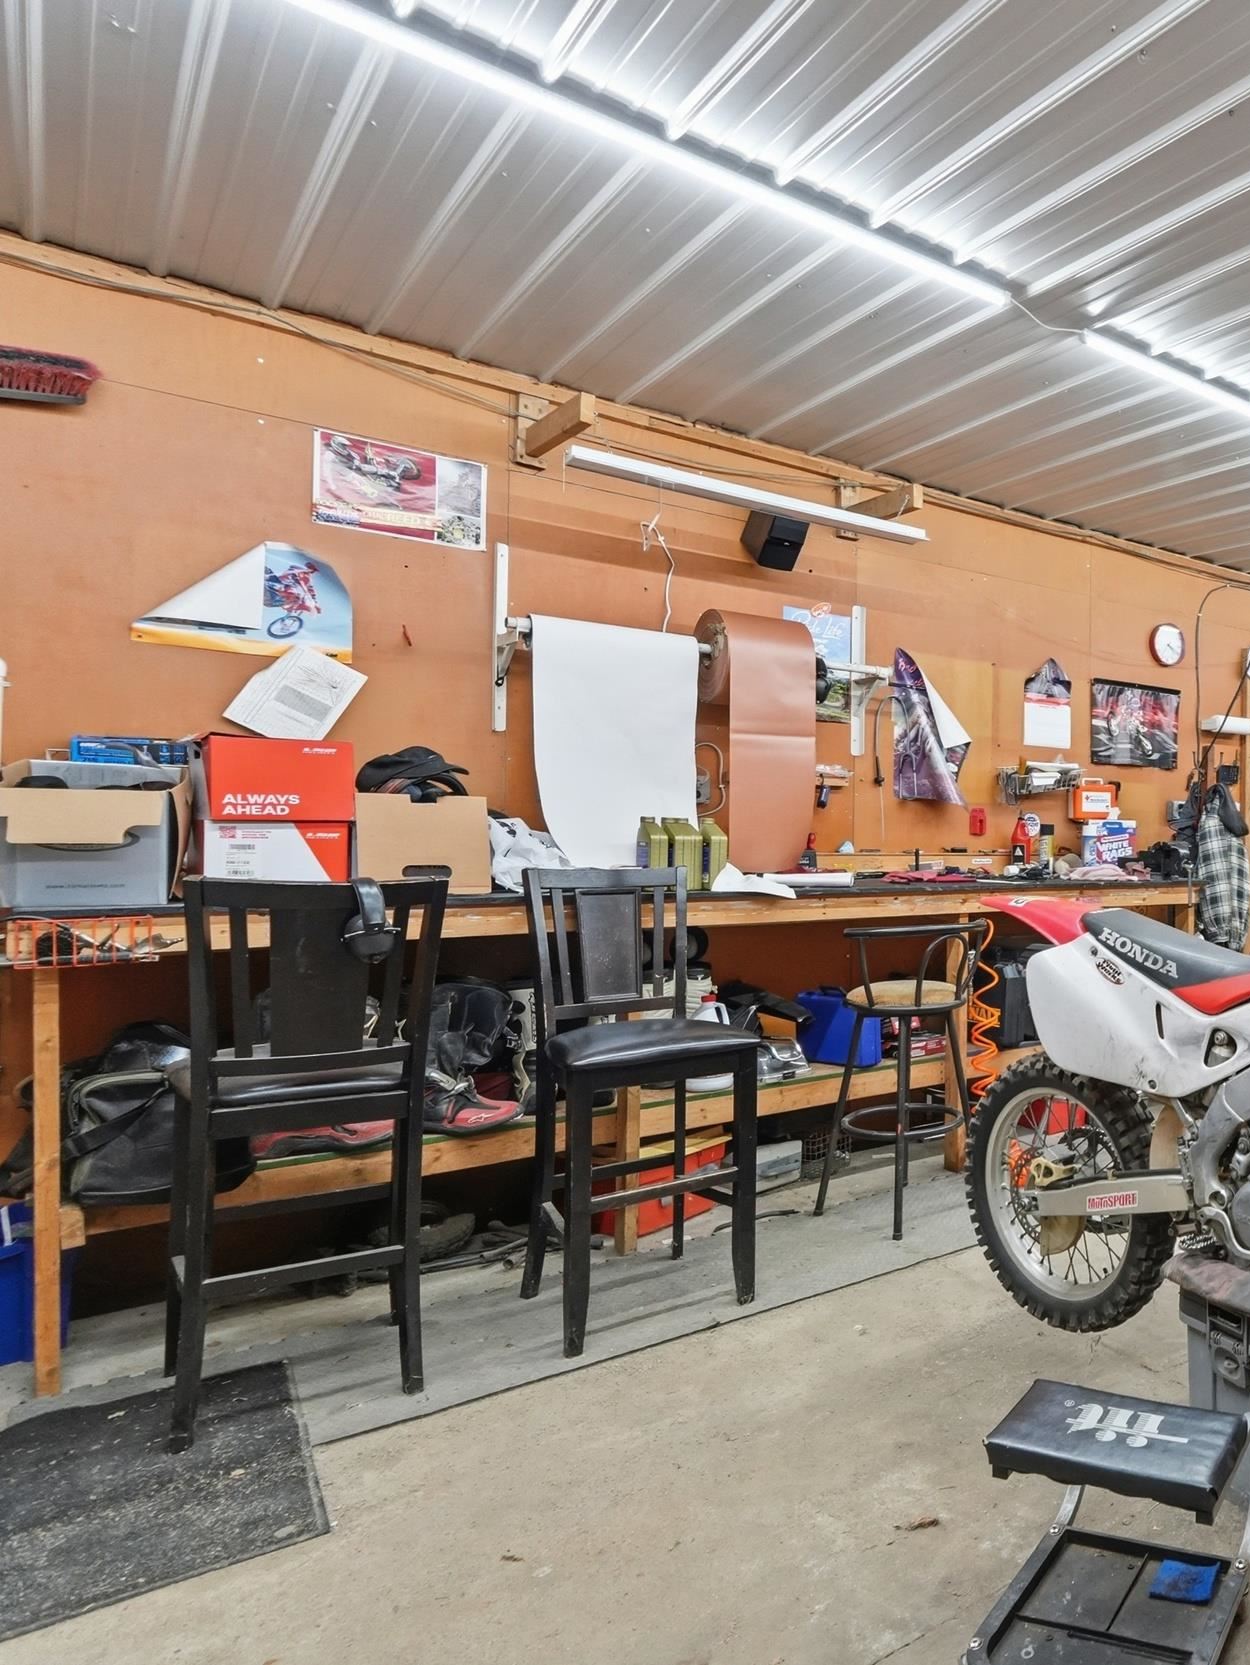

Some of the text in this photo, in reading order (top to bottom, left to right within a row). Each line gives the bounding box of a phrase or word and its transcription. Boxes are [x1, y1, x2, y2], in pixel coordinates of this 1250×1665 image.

[221, 793, 301, 805] ALWAYS
[221, 804, 290, 816] AHEAD
[1096, 839, 1130, 852] WHITE
[1102, 846, 1133, 862] RAGS
[1097, 927, 1179, 979] HONDA
